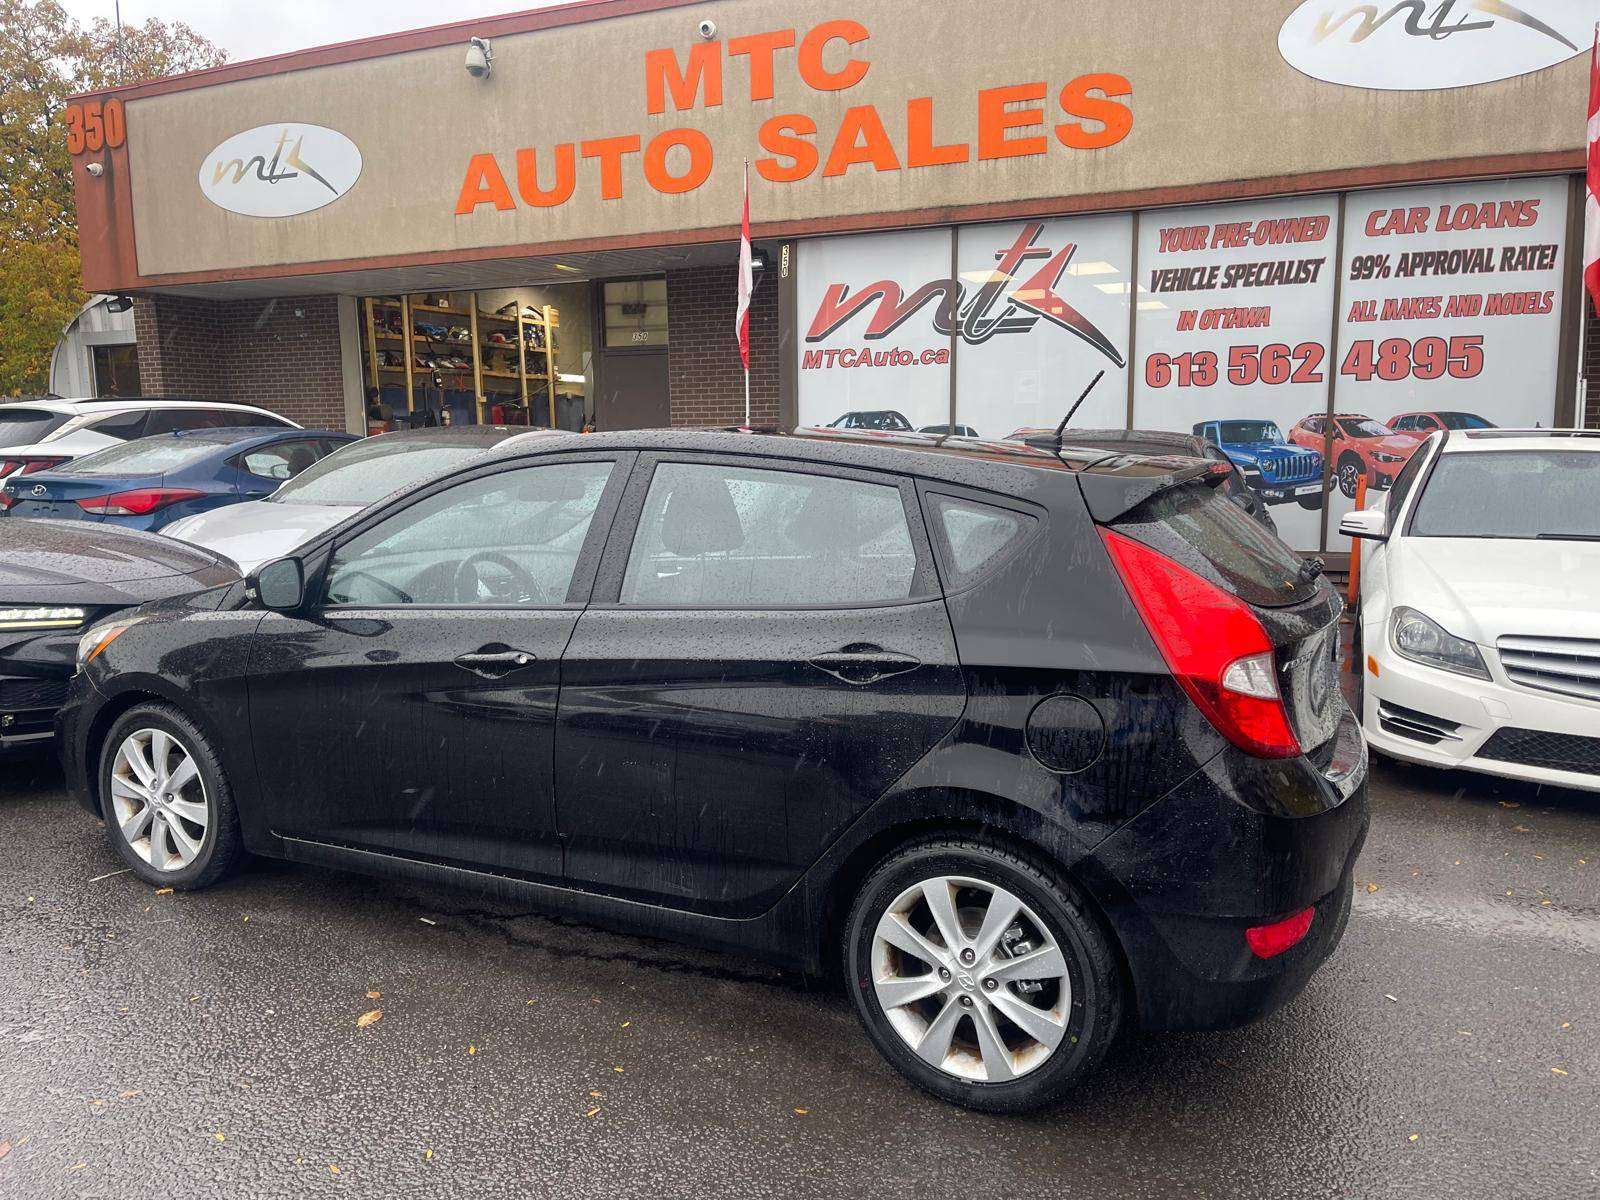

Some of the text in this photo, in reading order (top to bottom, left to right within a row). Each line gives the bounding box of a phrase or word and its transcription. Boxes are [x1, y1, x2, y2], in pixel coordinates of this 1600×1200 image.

[645, 18, 871, 116] MTC
[65, 97, 126, 155] 350
[454, 72, 1134, 215] AUTO SALES
[1158, 215, 1331, 253] YOUR PRE-OWNED
[1364, 199, 1541, 237] CAR LOANS
[1149, 256, 1327, 293] VEHICLE SPECIALIST
[1349, 244, 1559, 280] 99% APPROVAL RATE!
[1176, 305, 1271, 331] IN OTTAWA
[1347, 290, 1555, 323] ALL MAKES AND MODELS
[801, 346, 951, 370] MTCAuto.ca
[1145, 335, 1485, 389] 613 562 4895
